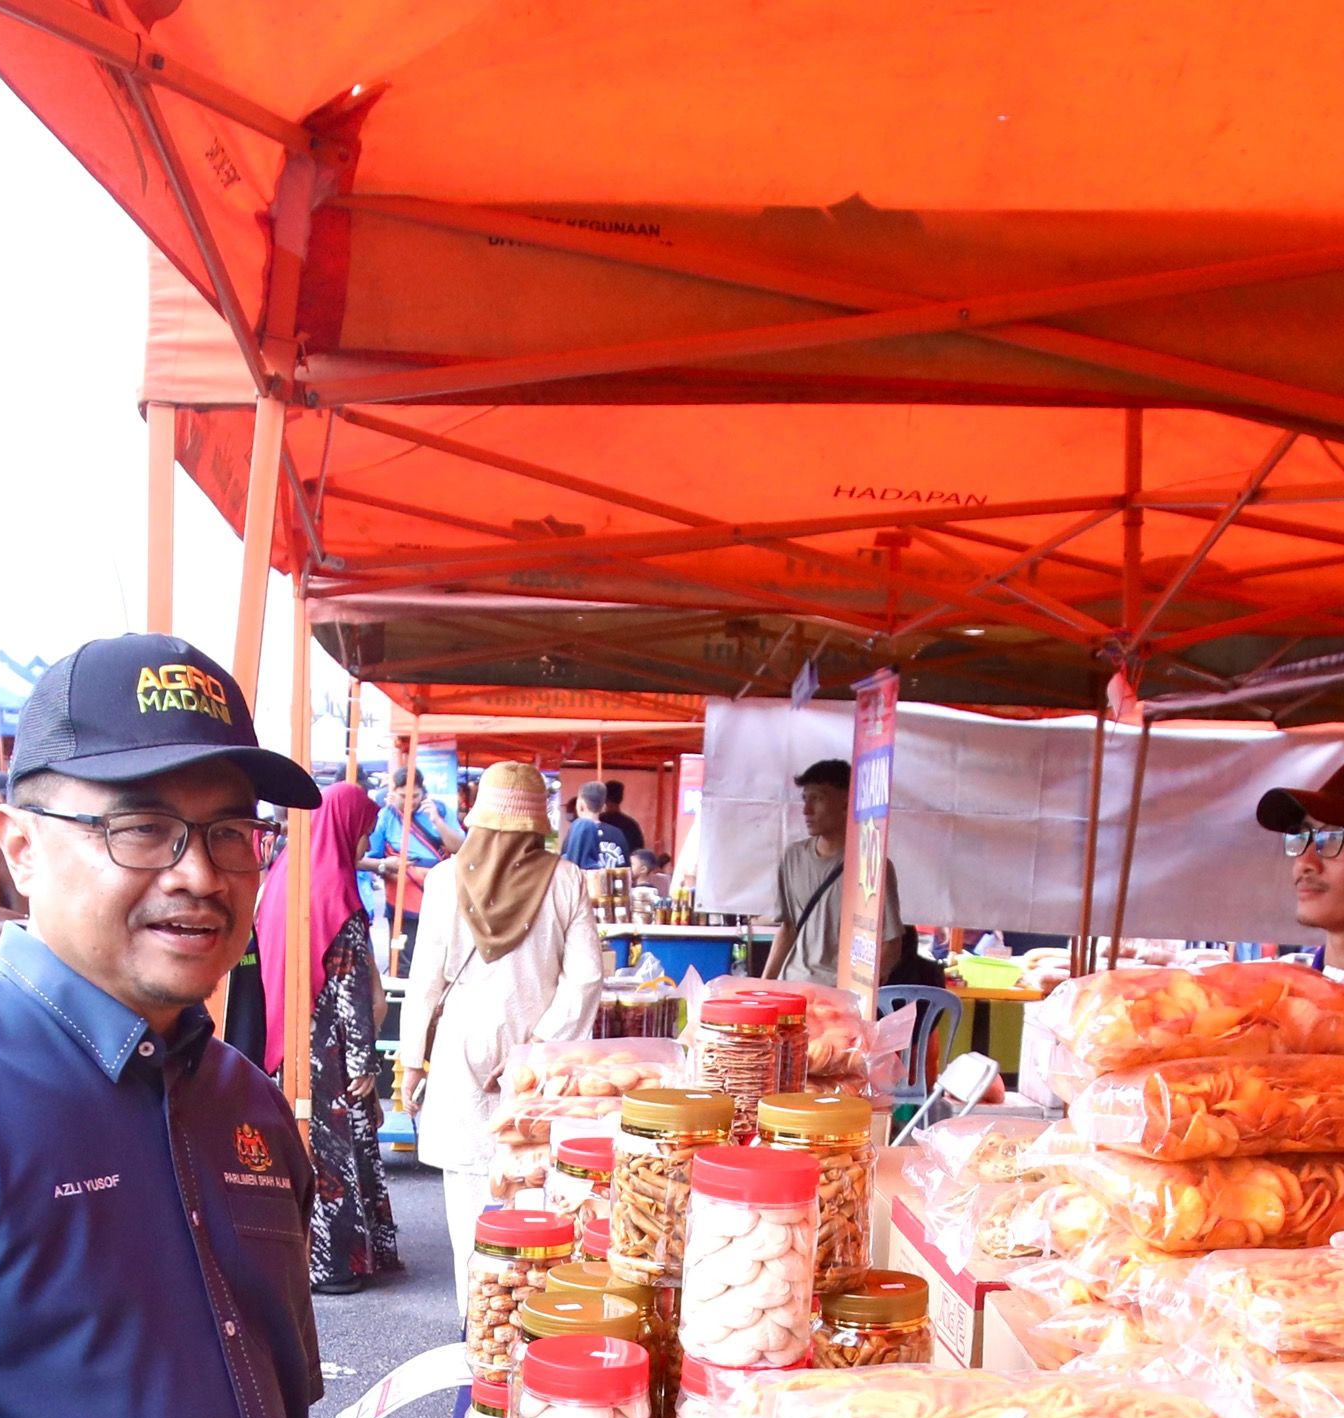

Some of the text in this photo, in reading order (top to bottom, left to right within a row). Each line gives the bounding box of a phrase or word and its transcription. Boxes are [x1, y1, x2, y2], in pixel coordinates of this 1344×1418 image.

[832, 484, 988, 506] HADAPAN
[136, 664, 227, 705] AGRO
[136, 689, 232, 726] MADANI
[54, 1174, 120, 1199] AZLI YUSOF
